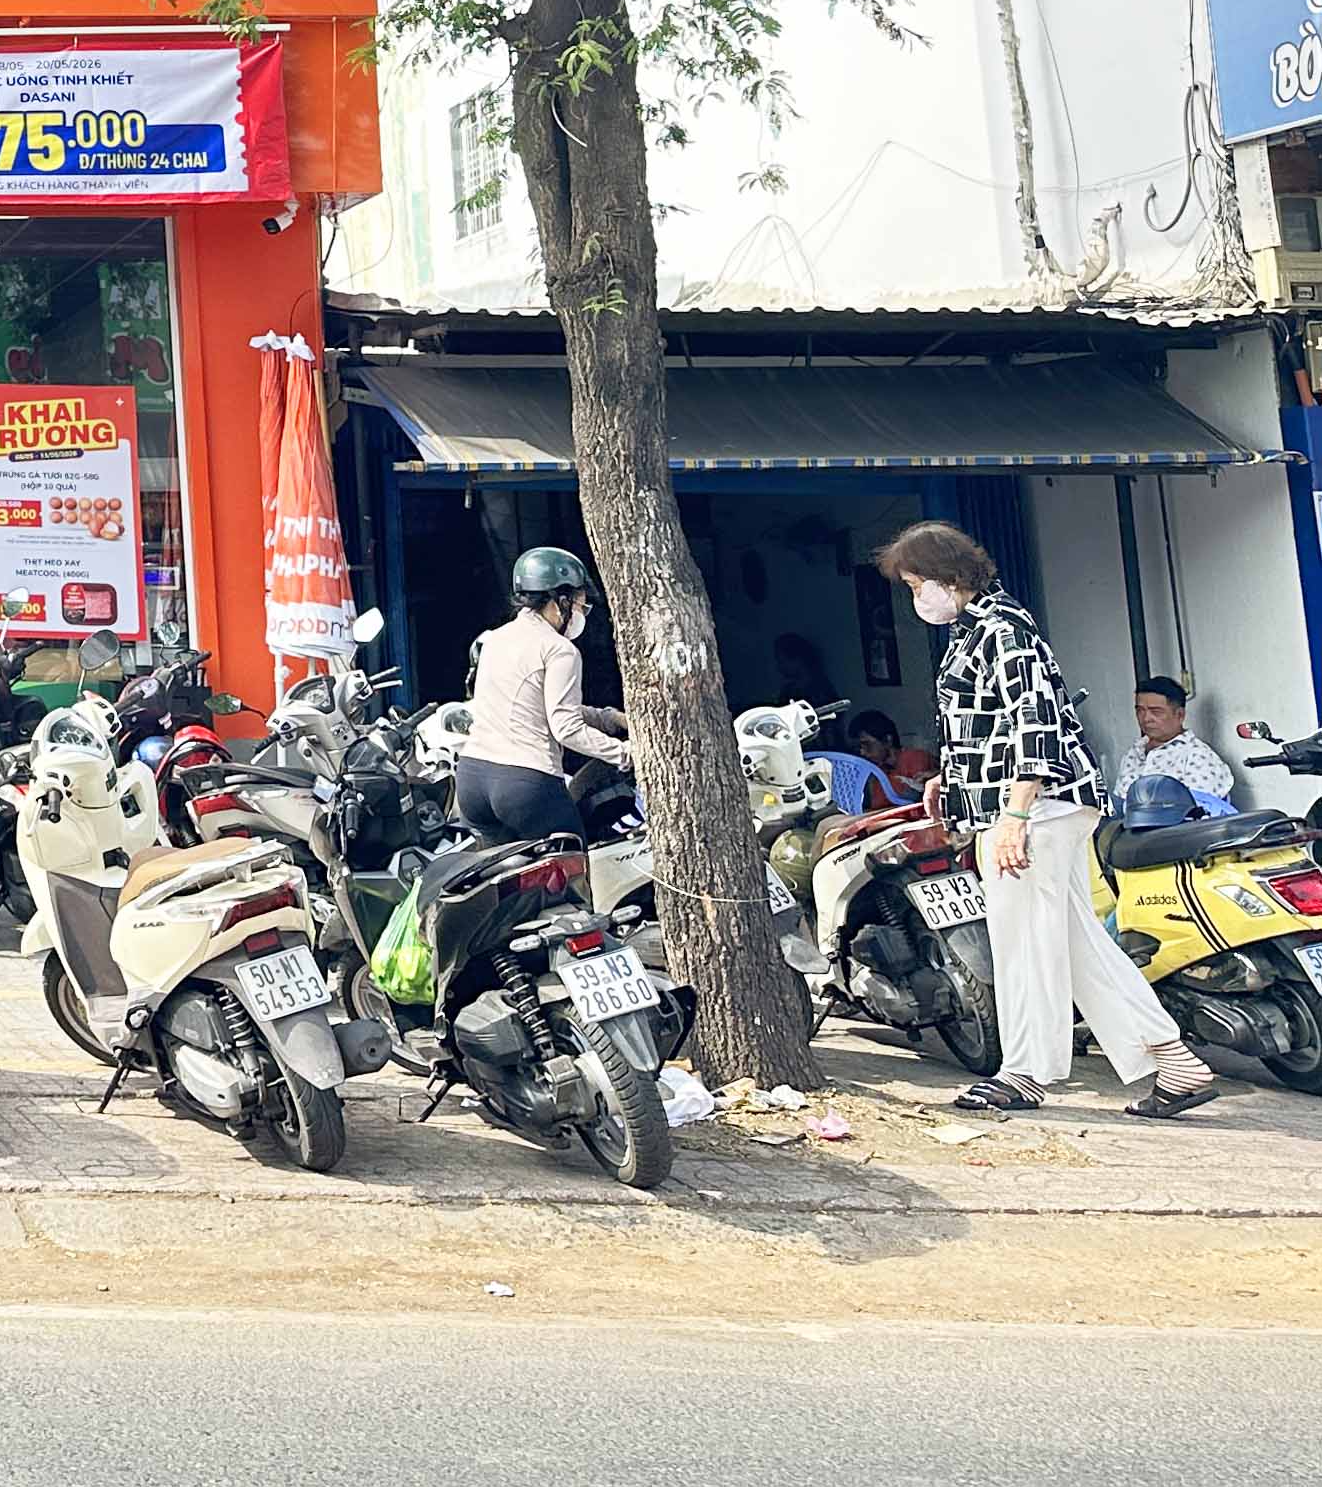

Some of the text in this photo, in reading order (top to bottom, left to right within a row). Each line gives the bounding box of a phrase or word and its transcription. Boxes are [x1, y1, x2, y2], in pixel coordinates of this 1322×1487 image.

[36, 59, 102, 71] 20/05/2026
[6, 70, 51, 87] UỐNG
[54, 74, 86, 87] TINH
[89, 70, 134, 87] KHIẾT
[20, 91, 76, 104] DASANI
[151, 152, 170, 169] 24
[173, 151, 208, 168] CHAI
[7, 401, 82, 425] KHAI
[921, 876, 972, 903] 59-V3
[1144, 893, 1178, 906] adidas
[249, 952, 305, 990] 50-N1
[572, 952, 632, 992] 59-N3
[253, 975, 325, 1018] 545.53
